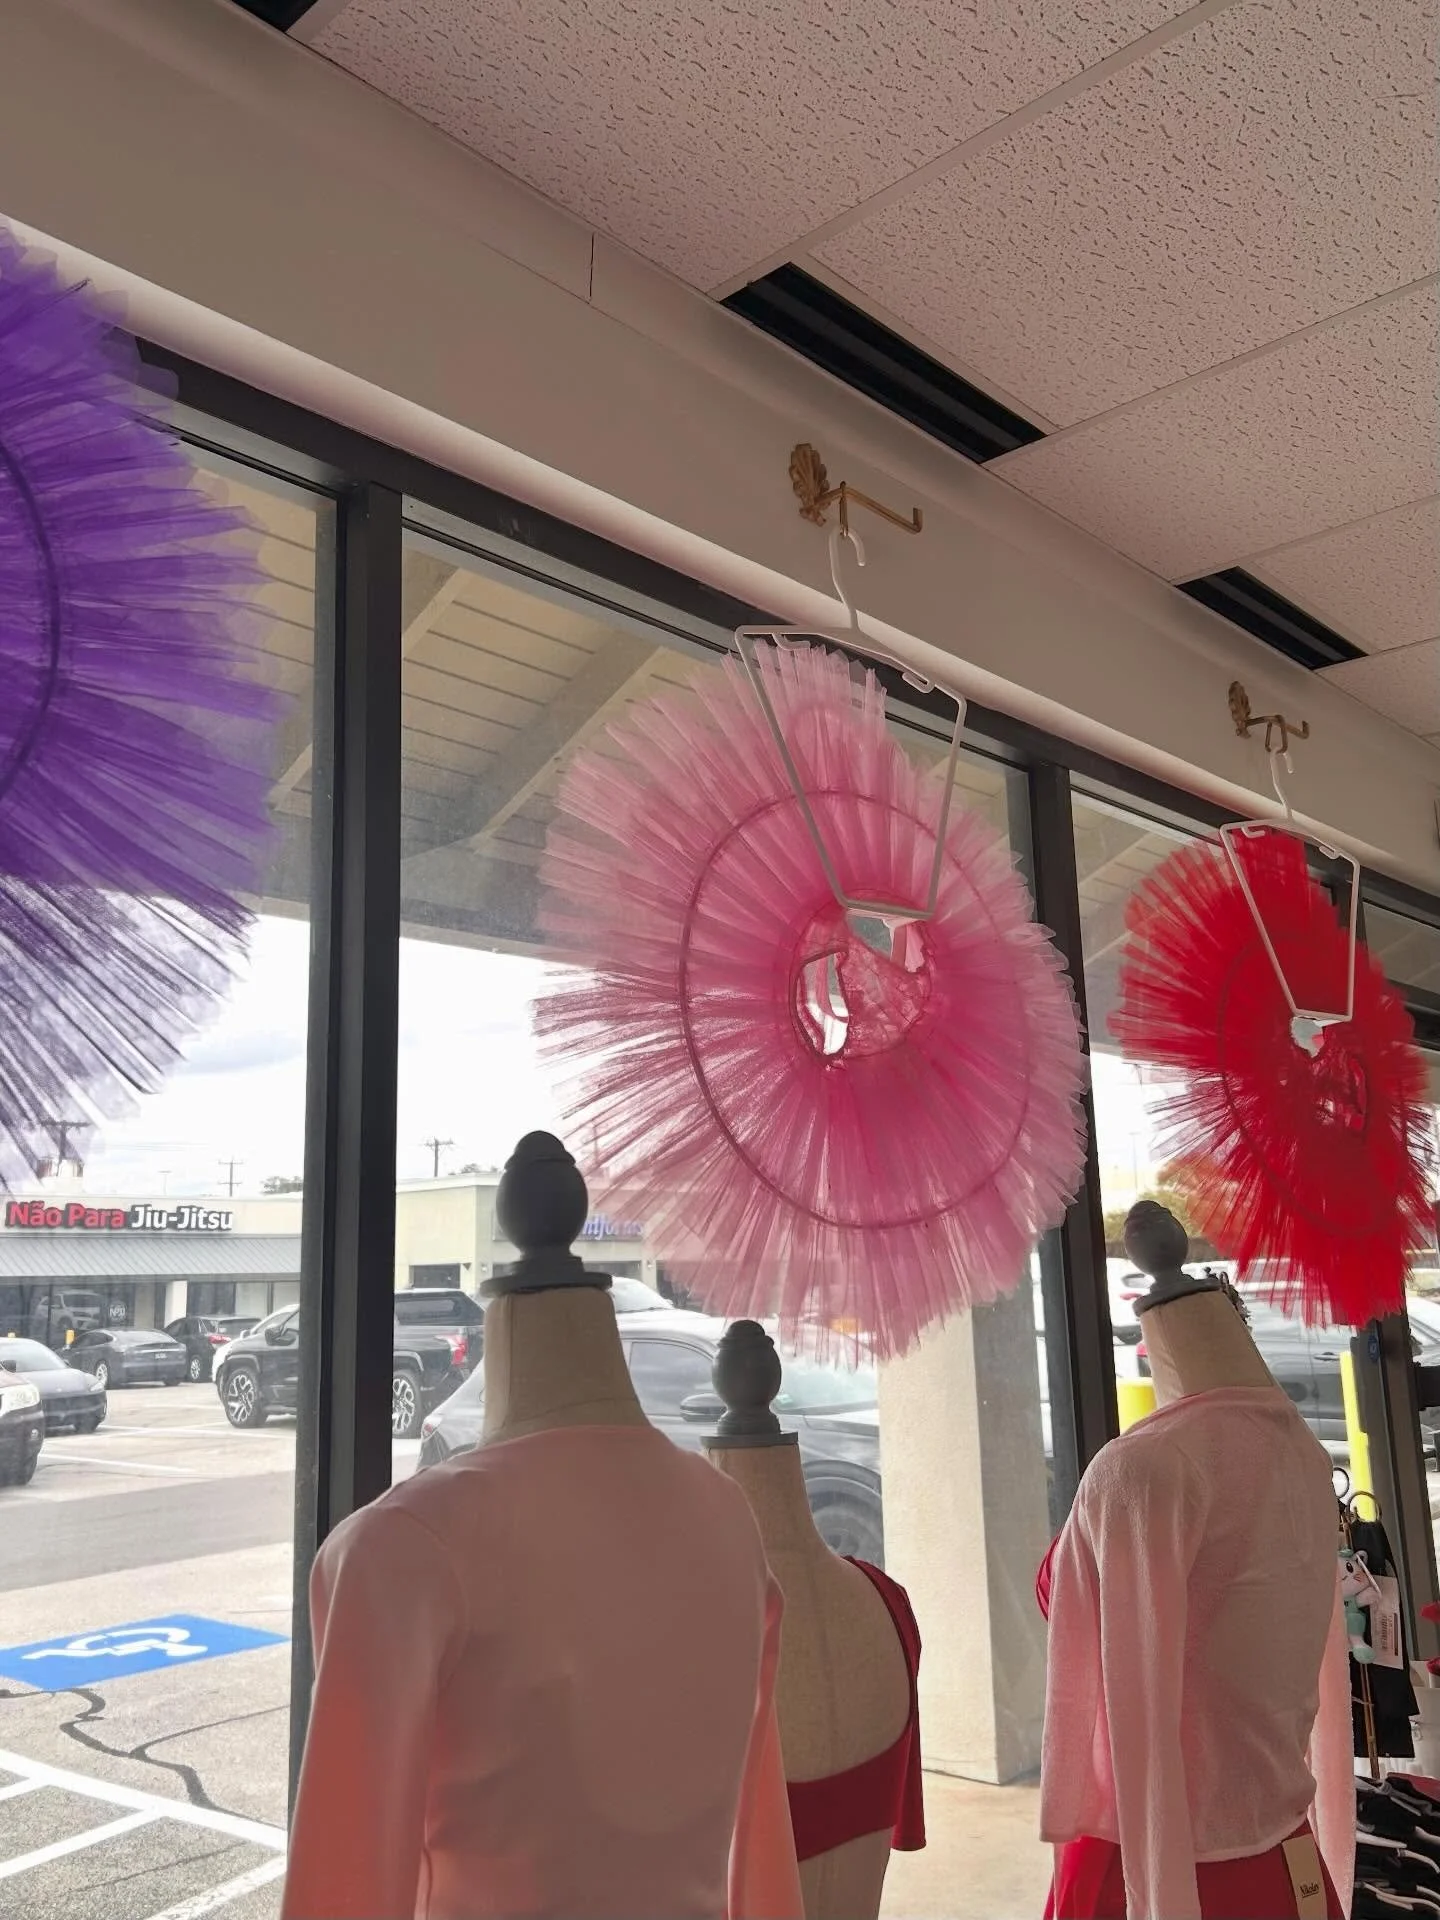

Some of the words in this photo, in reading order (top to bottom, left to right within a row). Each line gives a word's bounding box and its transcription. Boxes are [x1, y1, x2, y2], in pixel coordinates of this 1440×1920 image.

[7, 1201, 62, 1228] Não
[66, 1203, 126, 1228] Para
[131, 1204, 233, 1230] Jiu-Jitsu
